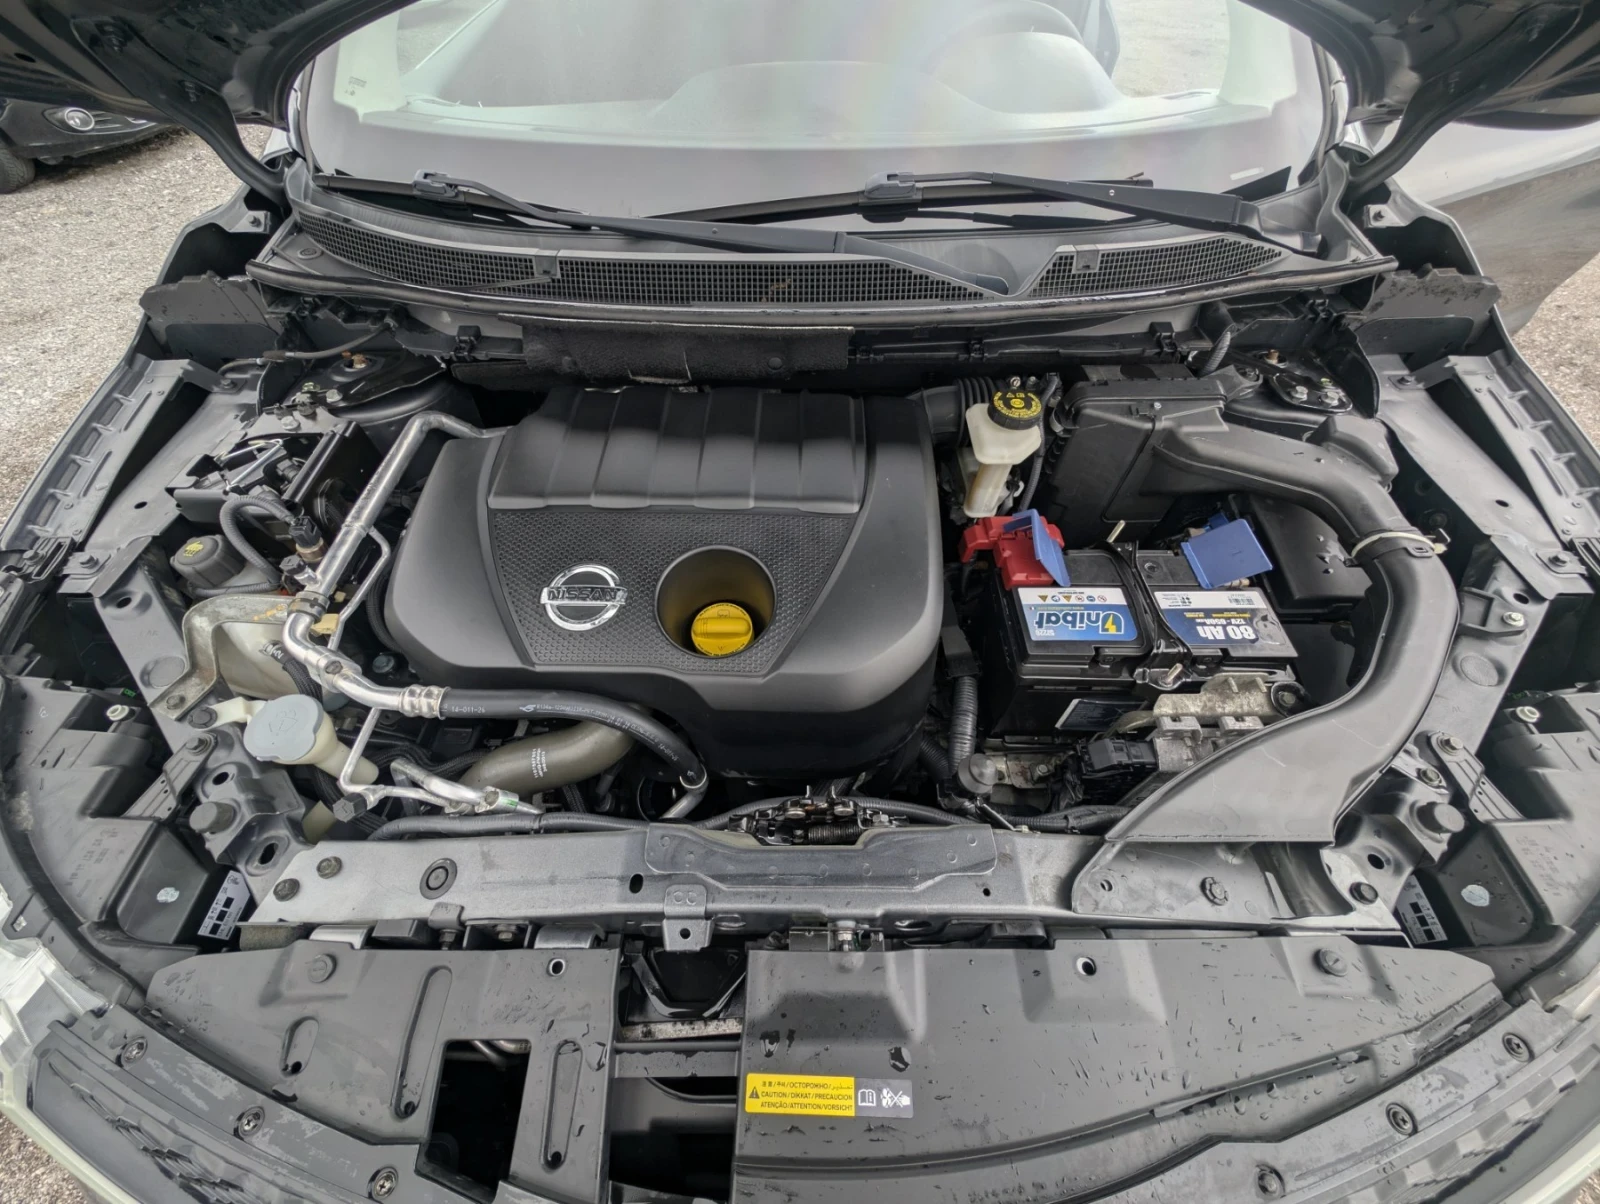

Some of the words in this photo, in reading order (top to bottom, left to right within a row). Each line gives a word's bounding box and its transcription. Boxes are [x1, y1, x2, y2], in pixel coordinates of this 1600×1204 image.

[547, 587, 617, 601] NISSAN
[1034, 611, 1124, 635] Unibat
[1196, 625, 1226, 640] Ah
[1226, 625, 1256, 640] 80
